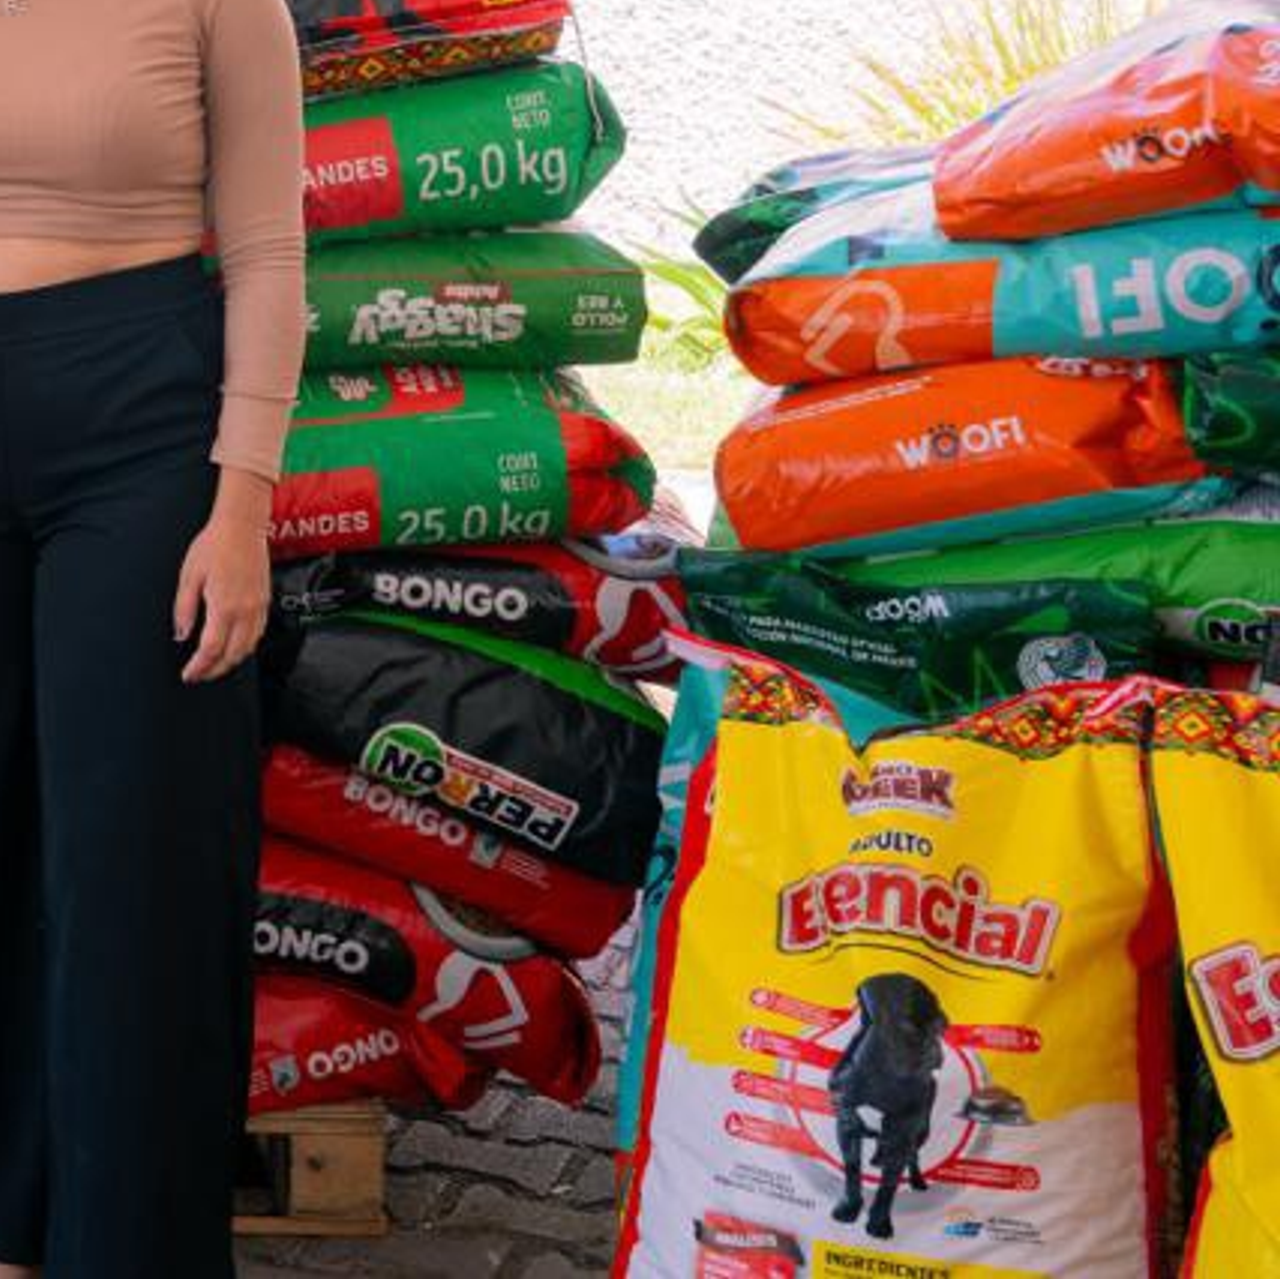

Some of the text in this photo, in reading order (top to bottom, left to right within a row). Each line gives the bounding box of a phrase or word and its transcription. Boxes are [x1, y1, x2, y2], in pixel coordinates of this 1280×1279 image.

[416, 139, 567, 201] 25,0 kg
[374, 572, 529, 621] BONGO
[344, 779, 468, 847] BONGO
[307, 1030, 400, 1080] ONGO
